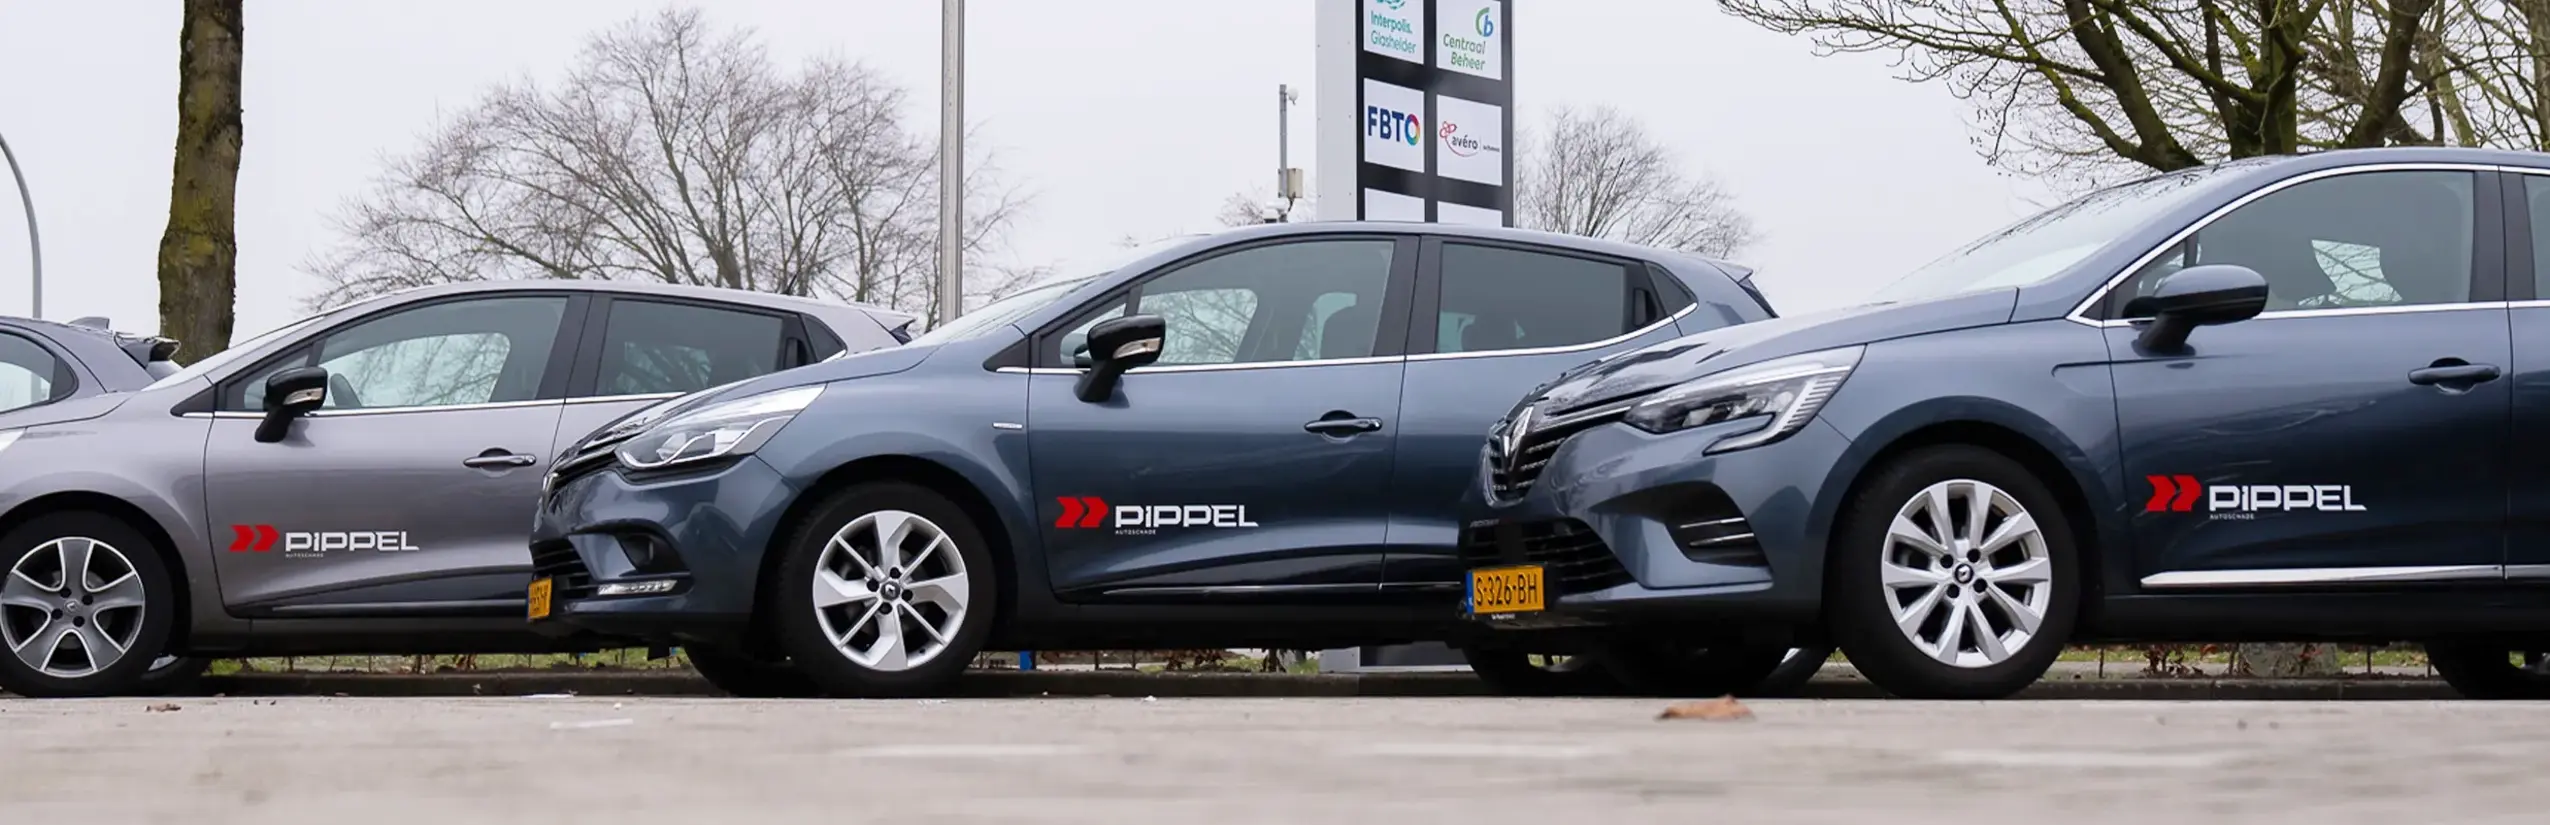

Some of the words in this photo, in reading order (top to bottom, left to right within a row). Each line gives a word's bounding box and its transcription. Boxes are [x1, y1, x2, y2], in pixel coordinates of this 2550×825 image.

[1443, 33, 1486, 55] Centraal
[1451, 51, 1486, 71] Beheer
[1368, 105, 1420, 146] FBTO
[1452, 134, 1478, 150] avéro
[1476, 573, 1537, 607] S-326-BH
